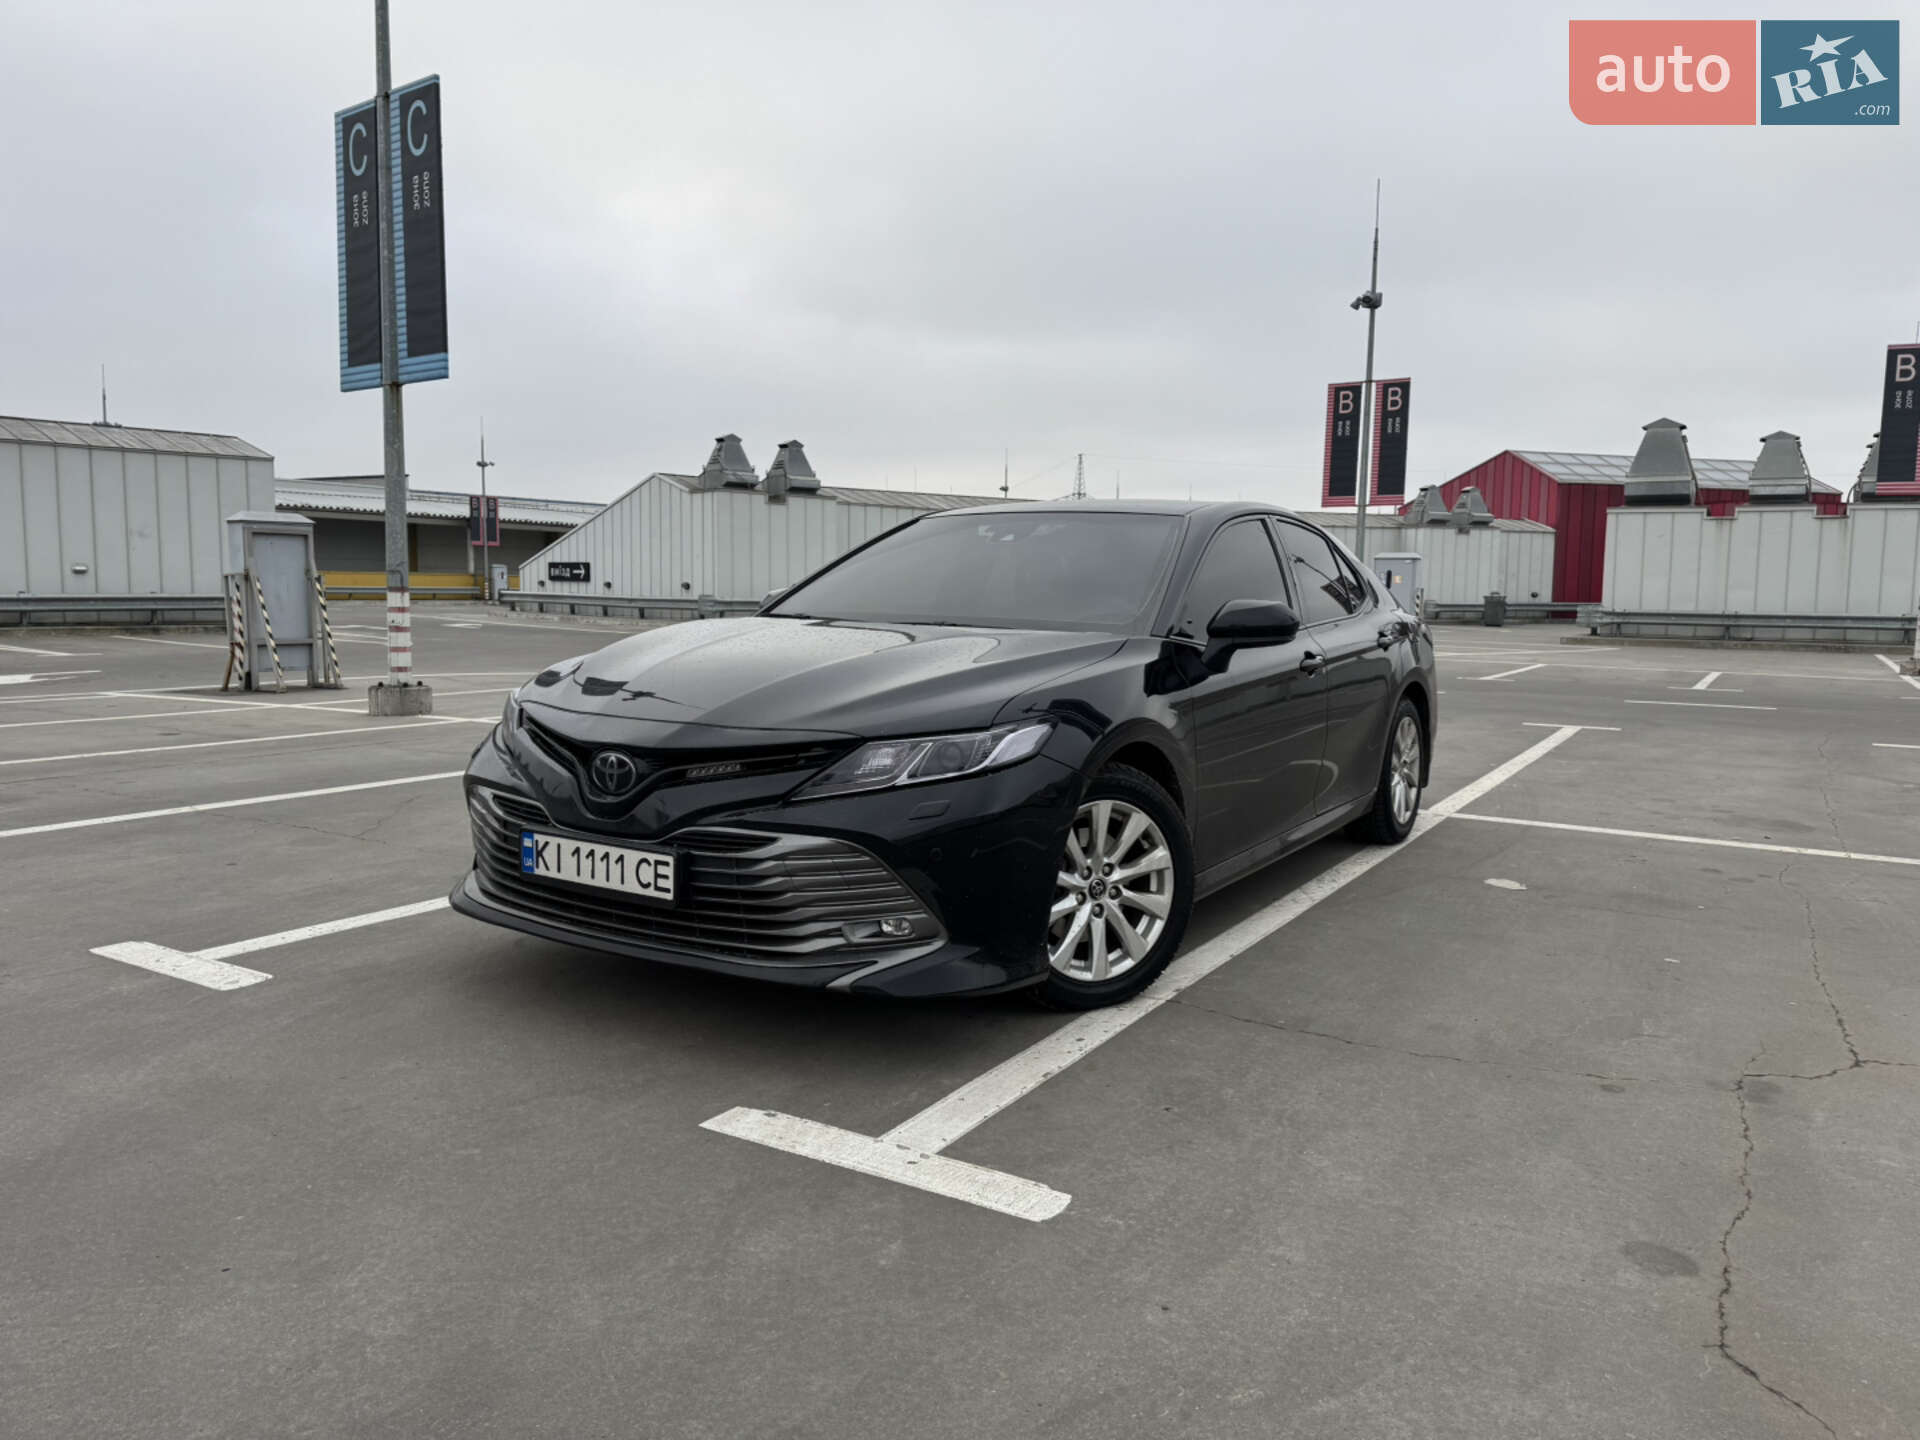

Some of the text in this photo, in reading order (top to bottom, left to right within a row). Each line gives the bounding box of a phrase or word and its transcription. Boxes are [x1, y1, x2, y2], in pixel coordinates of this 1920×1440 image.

[407, 99, 428, 157] C
[349, 122, 368, 177] C
[361, 190, 369, 225] zone
[423, 171, 431, 208] zone
[1895, 353, 1917, 382] B
[1338, 390, 1354, 414] B
[1386, 386, 1403, 412] B
[534, 839, 672, 894] KI 1111 CE
